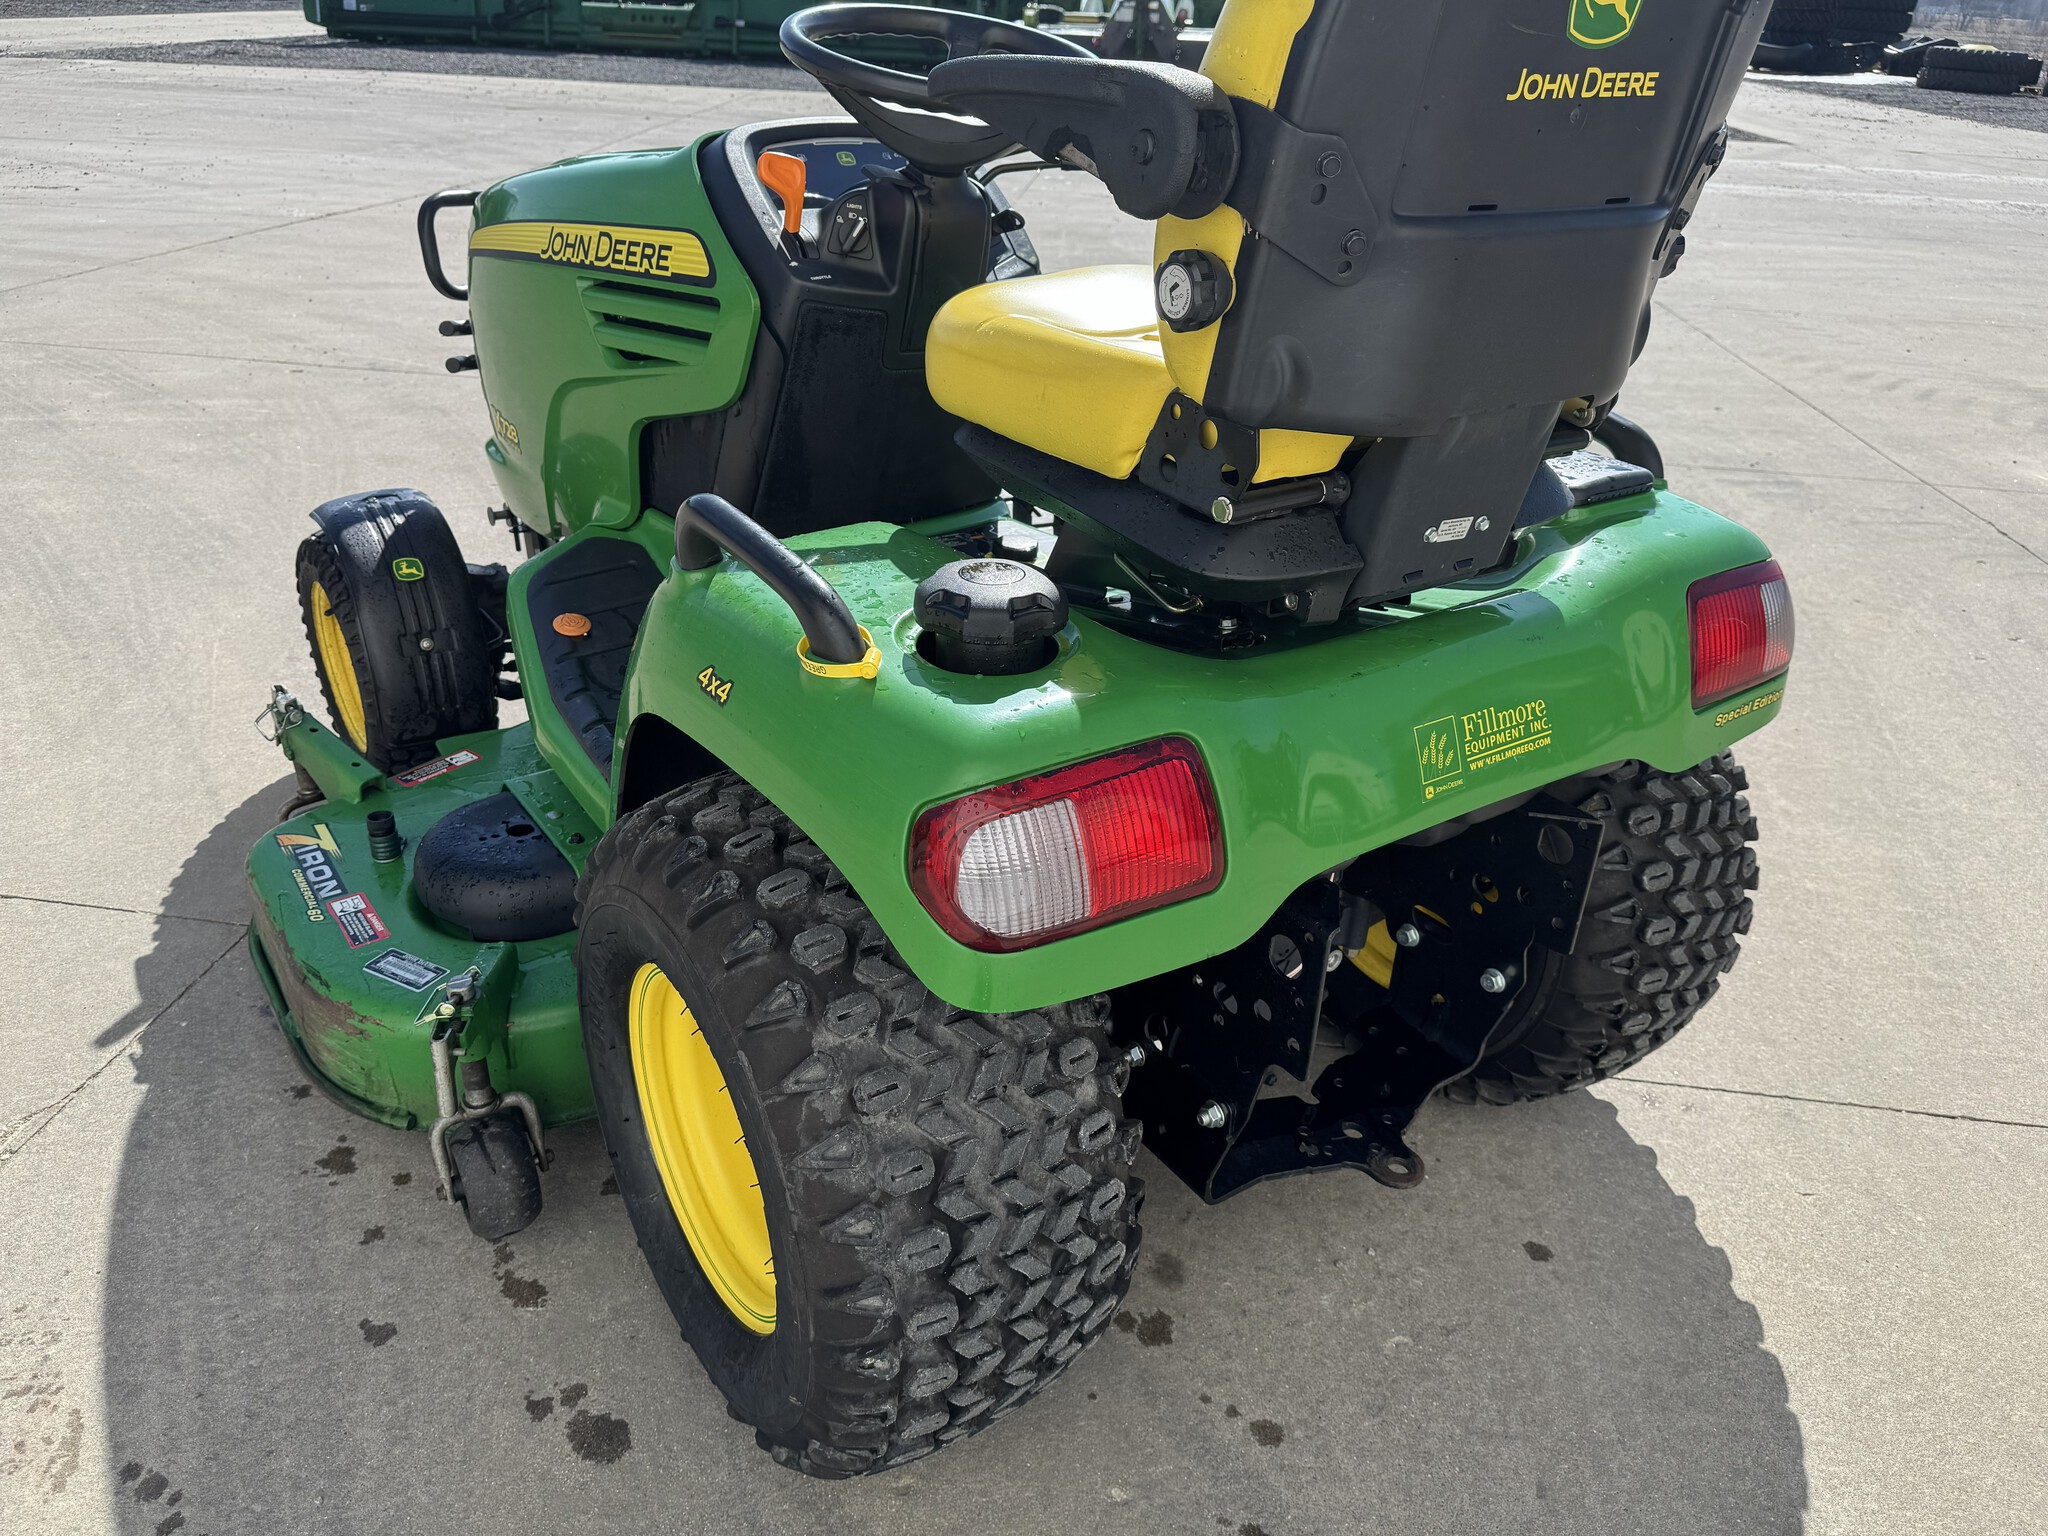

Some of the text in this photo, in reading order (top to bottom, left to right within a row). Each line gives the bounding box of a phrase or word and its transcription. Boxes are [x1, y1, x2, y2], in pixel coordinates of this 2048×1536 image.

[1506, 67, 1660, 101] JOHN DEERE
[540, 226, 673, 273] JOHN DEERE
[698, 667, 732, 703] 4x4
[1460, 699, 1547, 742] Fillmore
[1714, 687, 1785, 728] Special Edition
[1464, 717, 1552, 755] EQUIPMENT INC.
[1435, 778, 1464, 794] JOHN DEERE
[291, 868, 325, 922] COMMERCIAL 60
